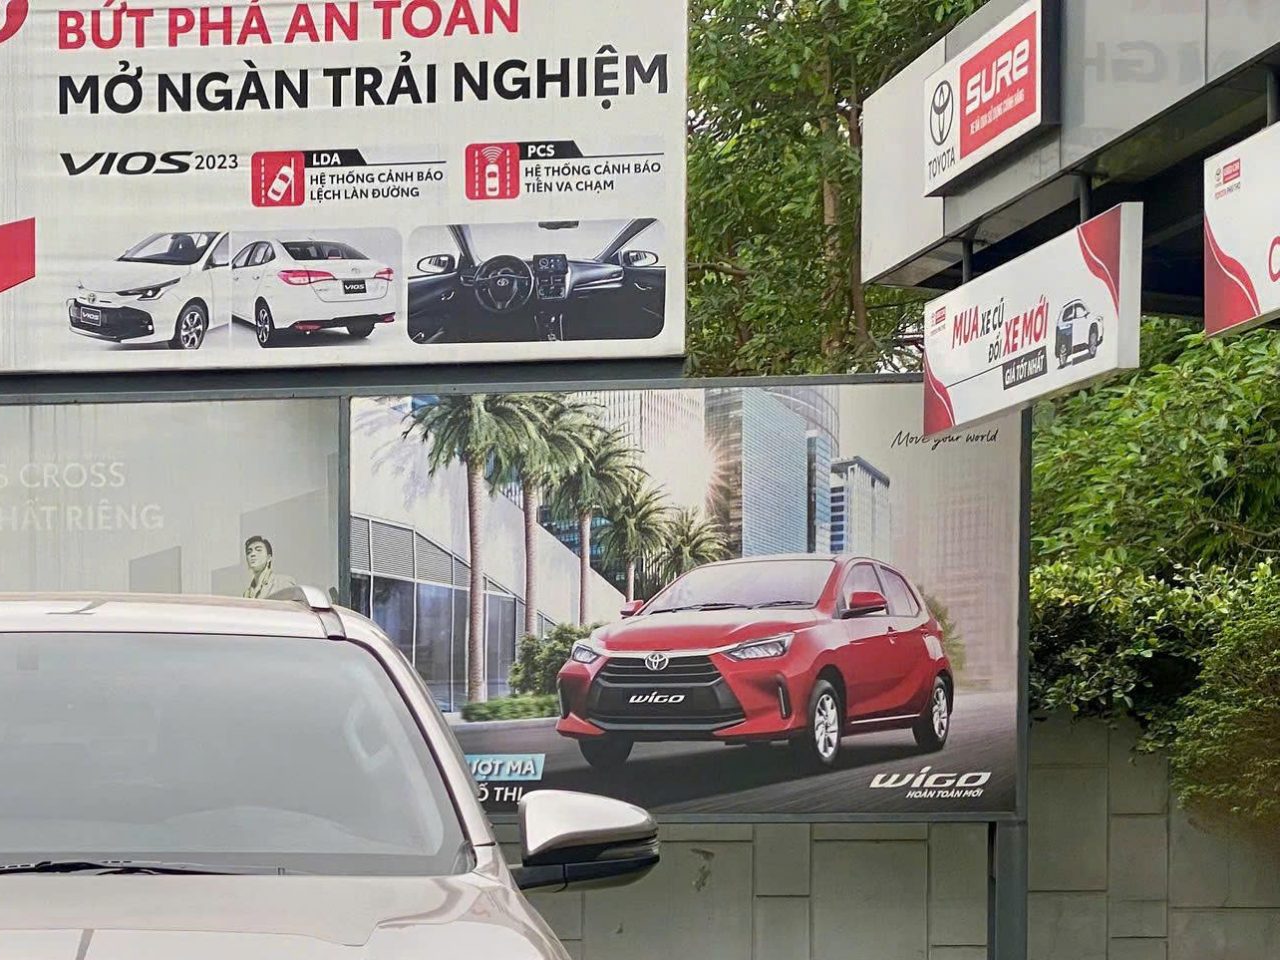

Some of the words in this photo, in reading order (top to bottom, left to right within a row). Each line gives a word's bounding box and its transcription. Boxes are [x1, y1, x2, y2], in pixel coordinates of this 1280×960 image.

[284, 2, 358, 43] AN
[59, 60, 143, 114] MỞ
[158, 59, 308, 113] NGÀN
[322, 51, 437, 107] TRẢI
[454, 44, 668, 110] NGHIỆM
[312, 153, 341, 166] LDA
[527, 145, 555, 158] PCS
[59, 151, 194, 175] VIOS
[195, 154, 238, 170] 2023
[525, 165, 541, 179] HỆ
[544, 162, 591, 176] THỐNG
[594, 162, 630, 175] CẢNH
[634, 162, 661, 174] BÁO
[928, 148, 956, 180] TOYOTA
[310, 172, 326, 187] HỆ
[329, 170, 375, 184] THỐNG
[377, 169, 414, 183] CẢNH
[417, 168, 444, 182] BÁO
[555, 181, 573, 192] VA
[576, 180, 614, 194] CHẠM
[310, 187, 341, 203] LỆCH
[344, 186, 369, 199] LÀN
[372, 185, 420, 198] ĐƯỜNG
[344, 283, 366, 291] VIOS
[951, 305, 979, 349] MUA
[980, 309, 991, 337] XE
[1002, 315, 1020, 357] XE
[1021, 294, 1049, 348] MỚI
[931, 434, 961, 450] your
[966, 429, 999, 442] world
[19, 462, 126, 489] CROSS
[68, 499, 165, 531] RIÊNG
